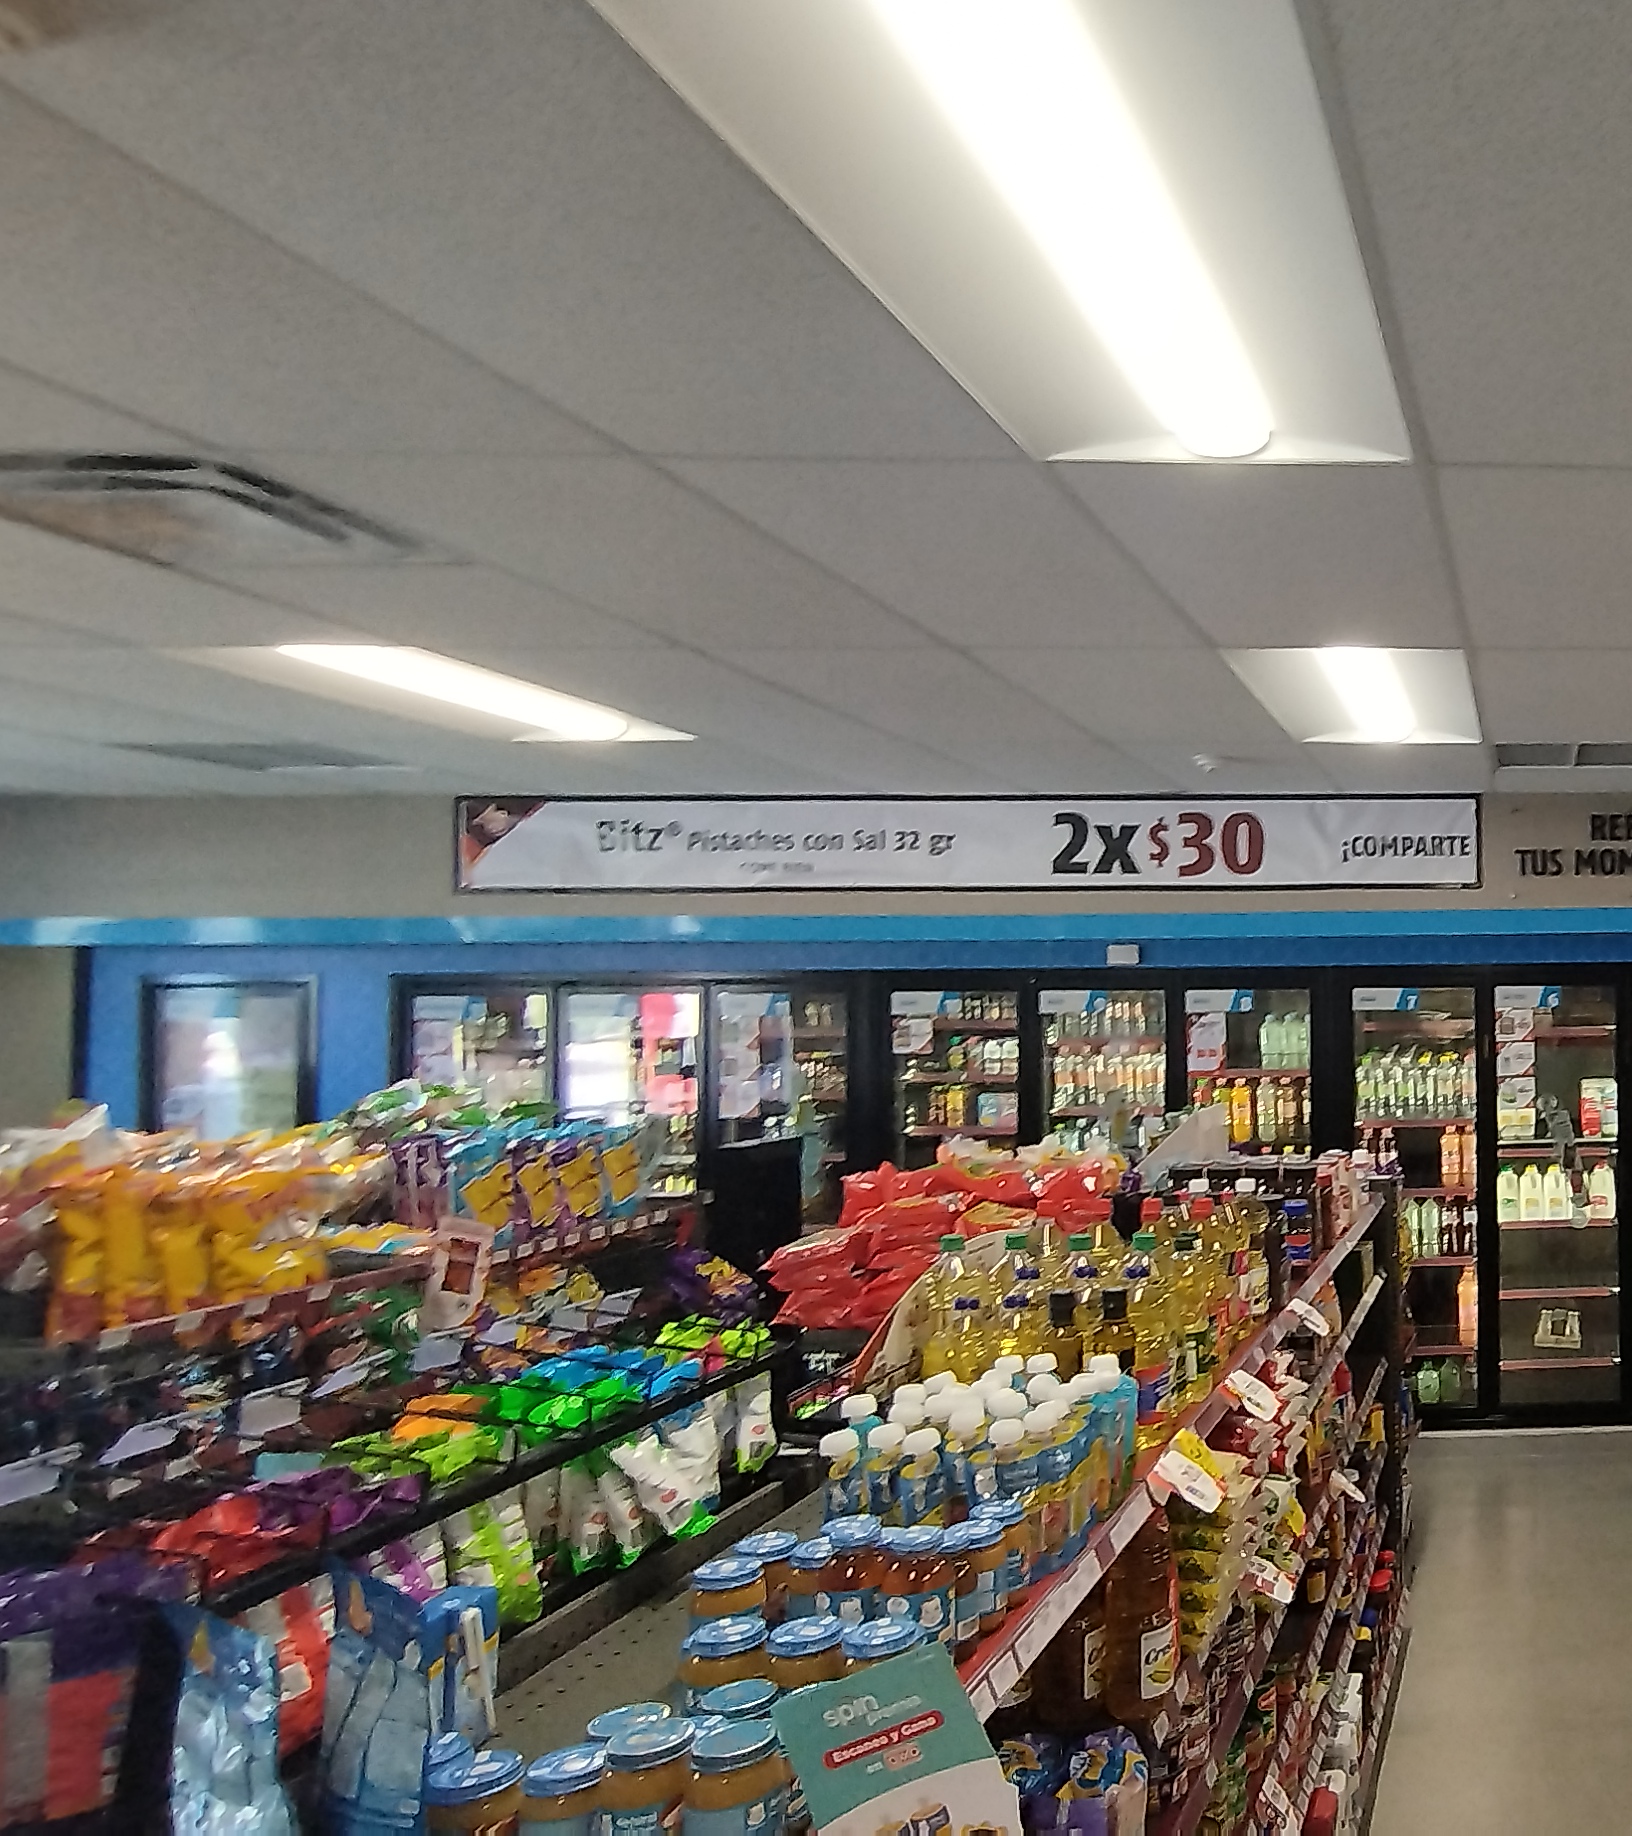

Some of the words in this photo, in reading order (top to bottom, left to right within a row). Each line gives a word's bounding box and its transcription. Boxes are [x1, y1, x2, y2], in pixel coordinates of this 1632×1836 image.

[687, 829, 795, 851] Pistaches
[803, 833, 844, 851] con
[853, 829, 887, 852] Sal
[894, 829, 921, 852] 32
[928, 832, 957, 857] gr
[1341, 835, 1471, 863] ¡COMPARTE
[1514, 848, 1564, 877] TUS
[1405, 995, 1418, 1010] 7
